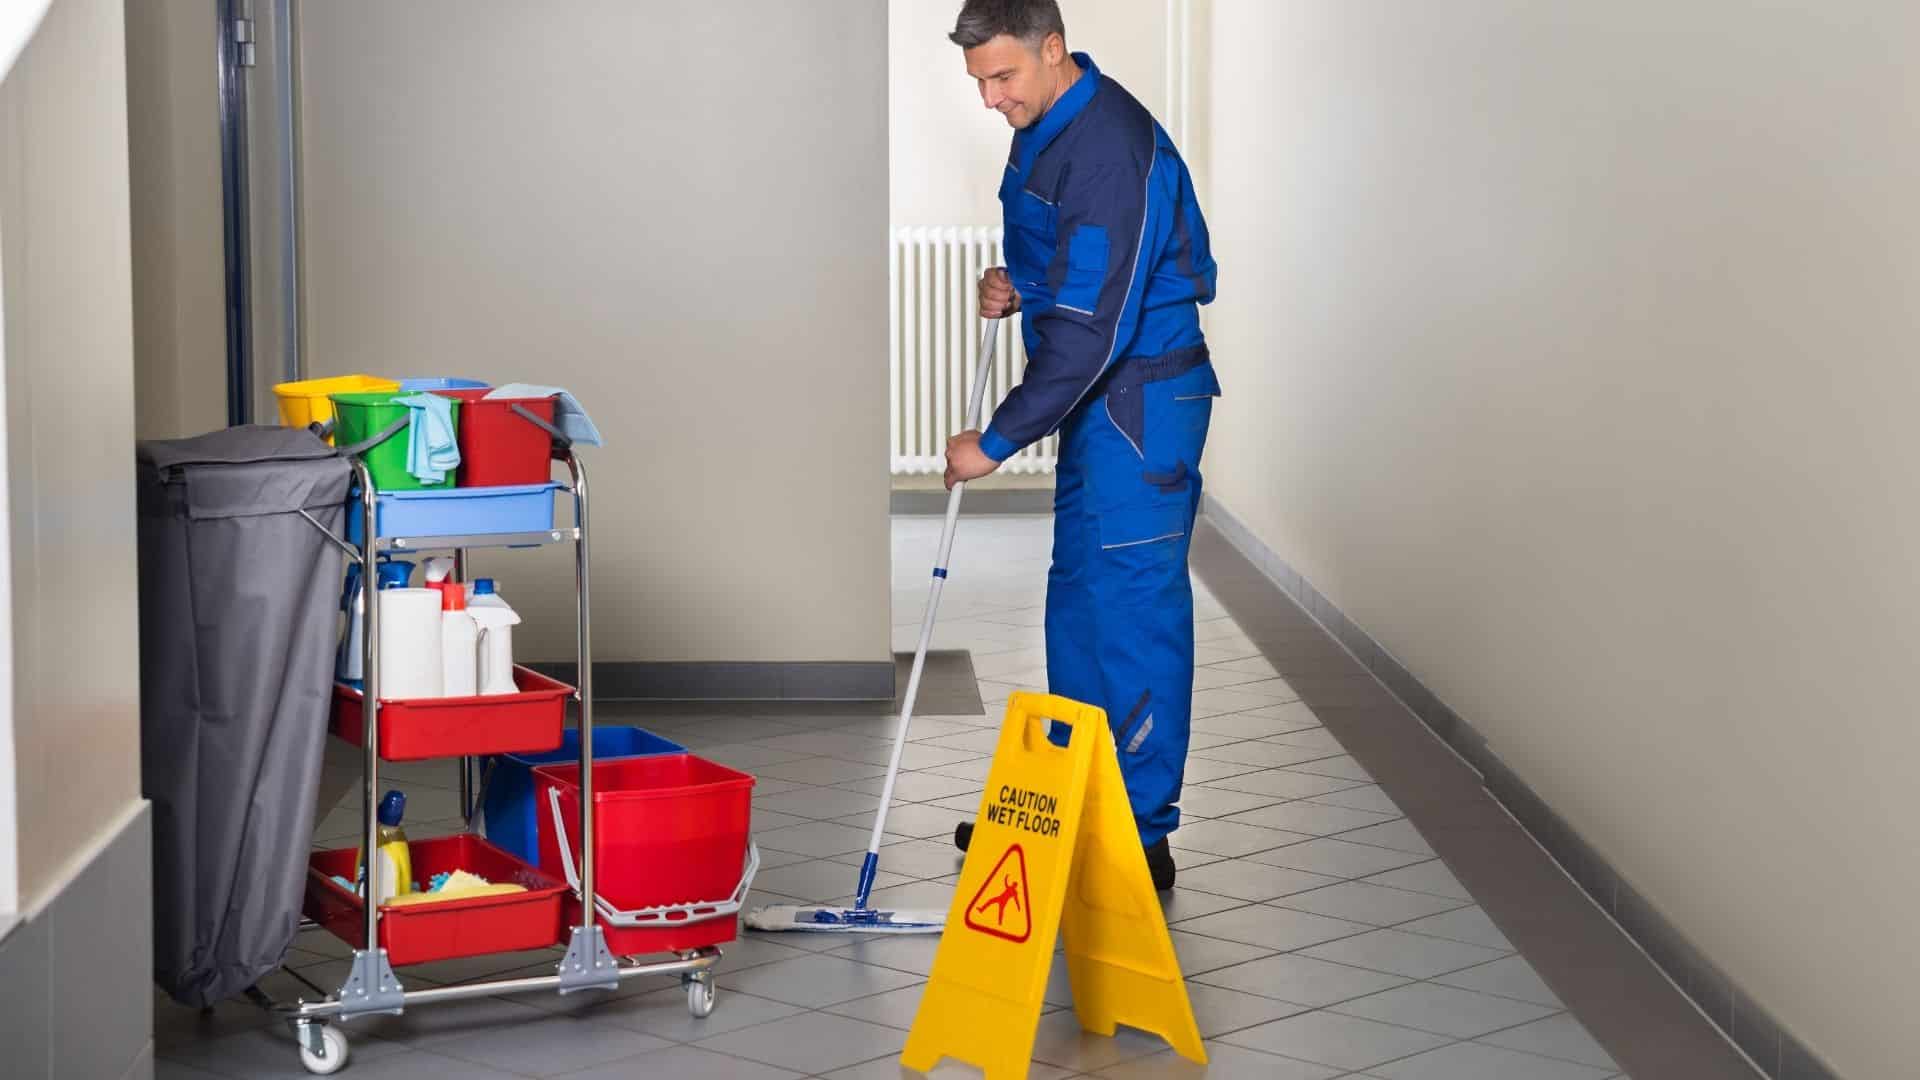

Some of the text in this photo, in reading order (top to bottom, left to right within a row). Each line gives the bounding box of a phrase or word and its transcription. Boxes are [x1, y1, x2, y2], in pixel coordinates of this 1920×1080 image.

[999, 785, 1057, 814] CAUTION
[987, 803, 1060, 837] WET FLOOR
